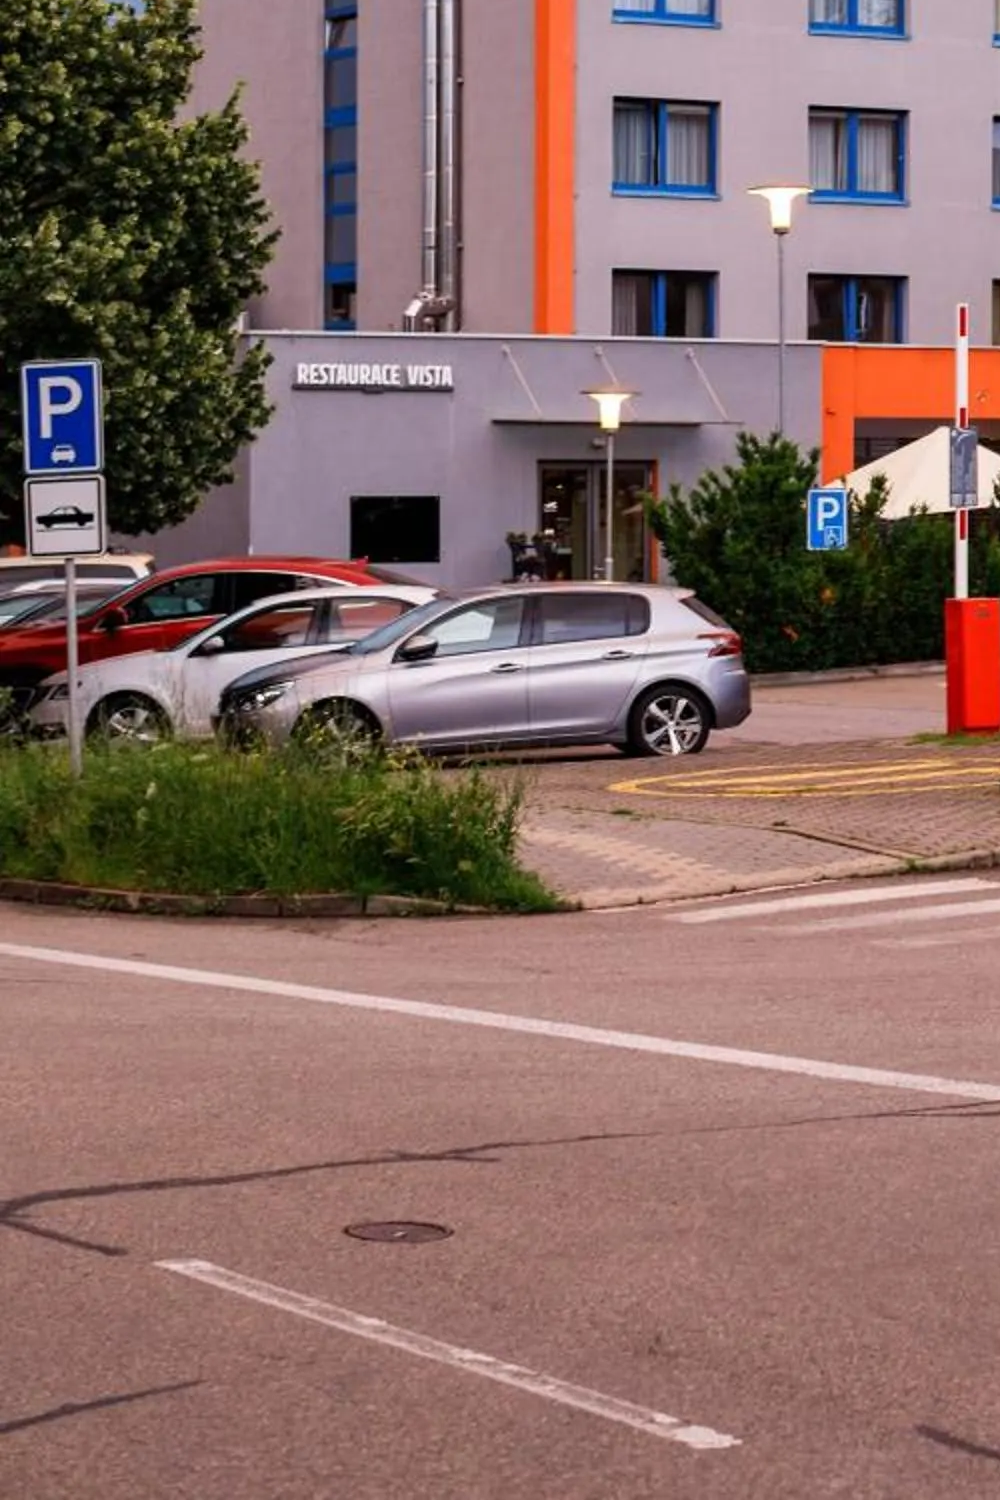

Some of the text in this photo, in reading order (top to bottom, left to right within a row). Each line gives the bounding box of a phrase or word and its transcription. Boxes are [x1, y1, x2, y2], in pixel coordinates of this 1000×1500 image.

[297, 363, 453, 386] RESTAURACE VISTA
[39, 376, 82, 439] P
[817, 497, 840, 531] P
